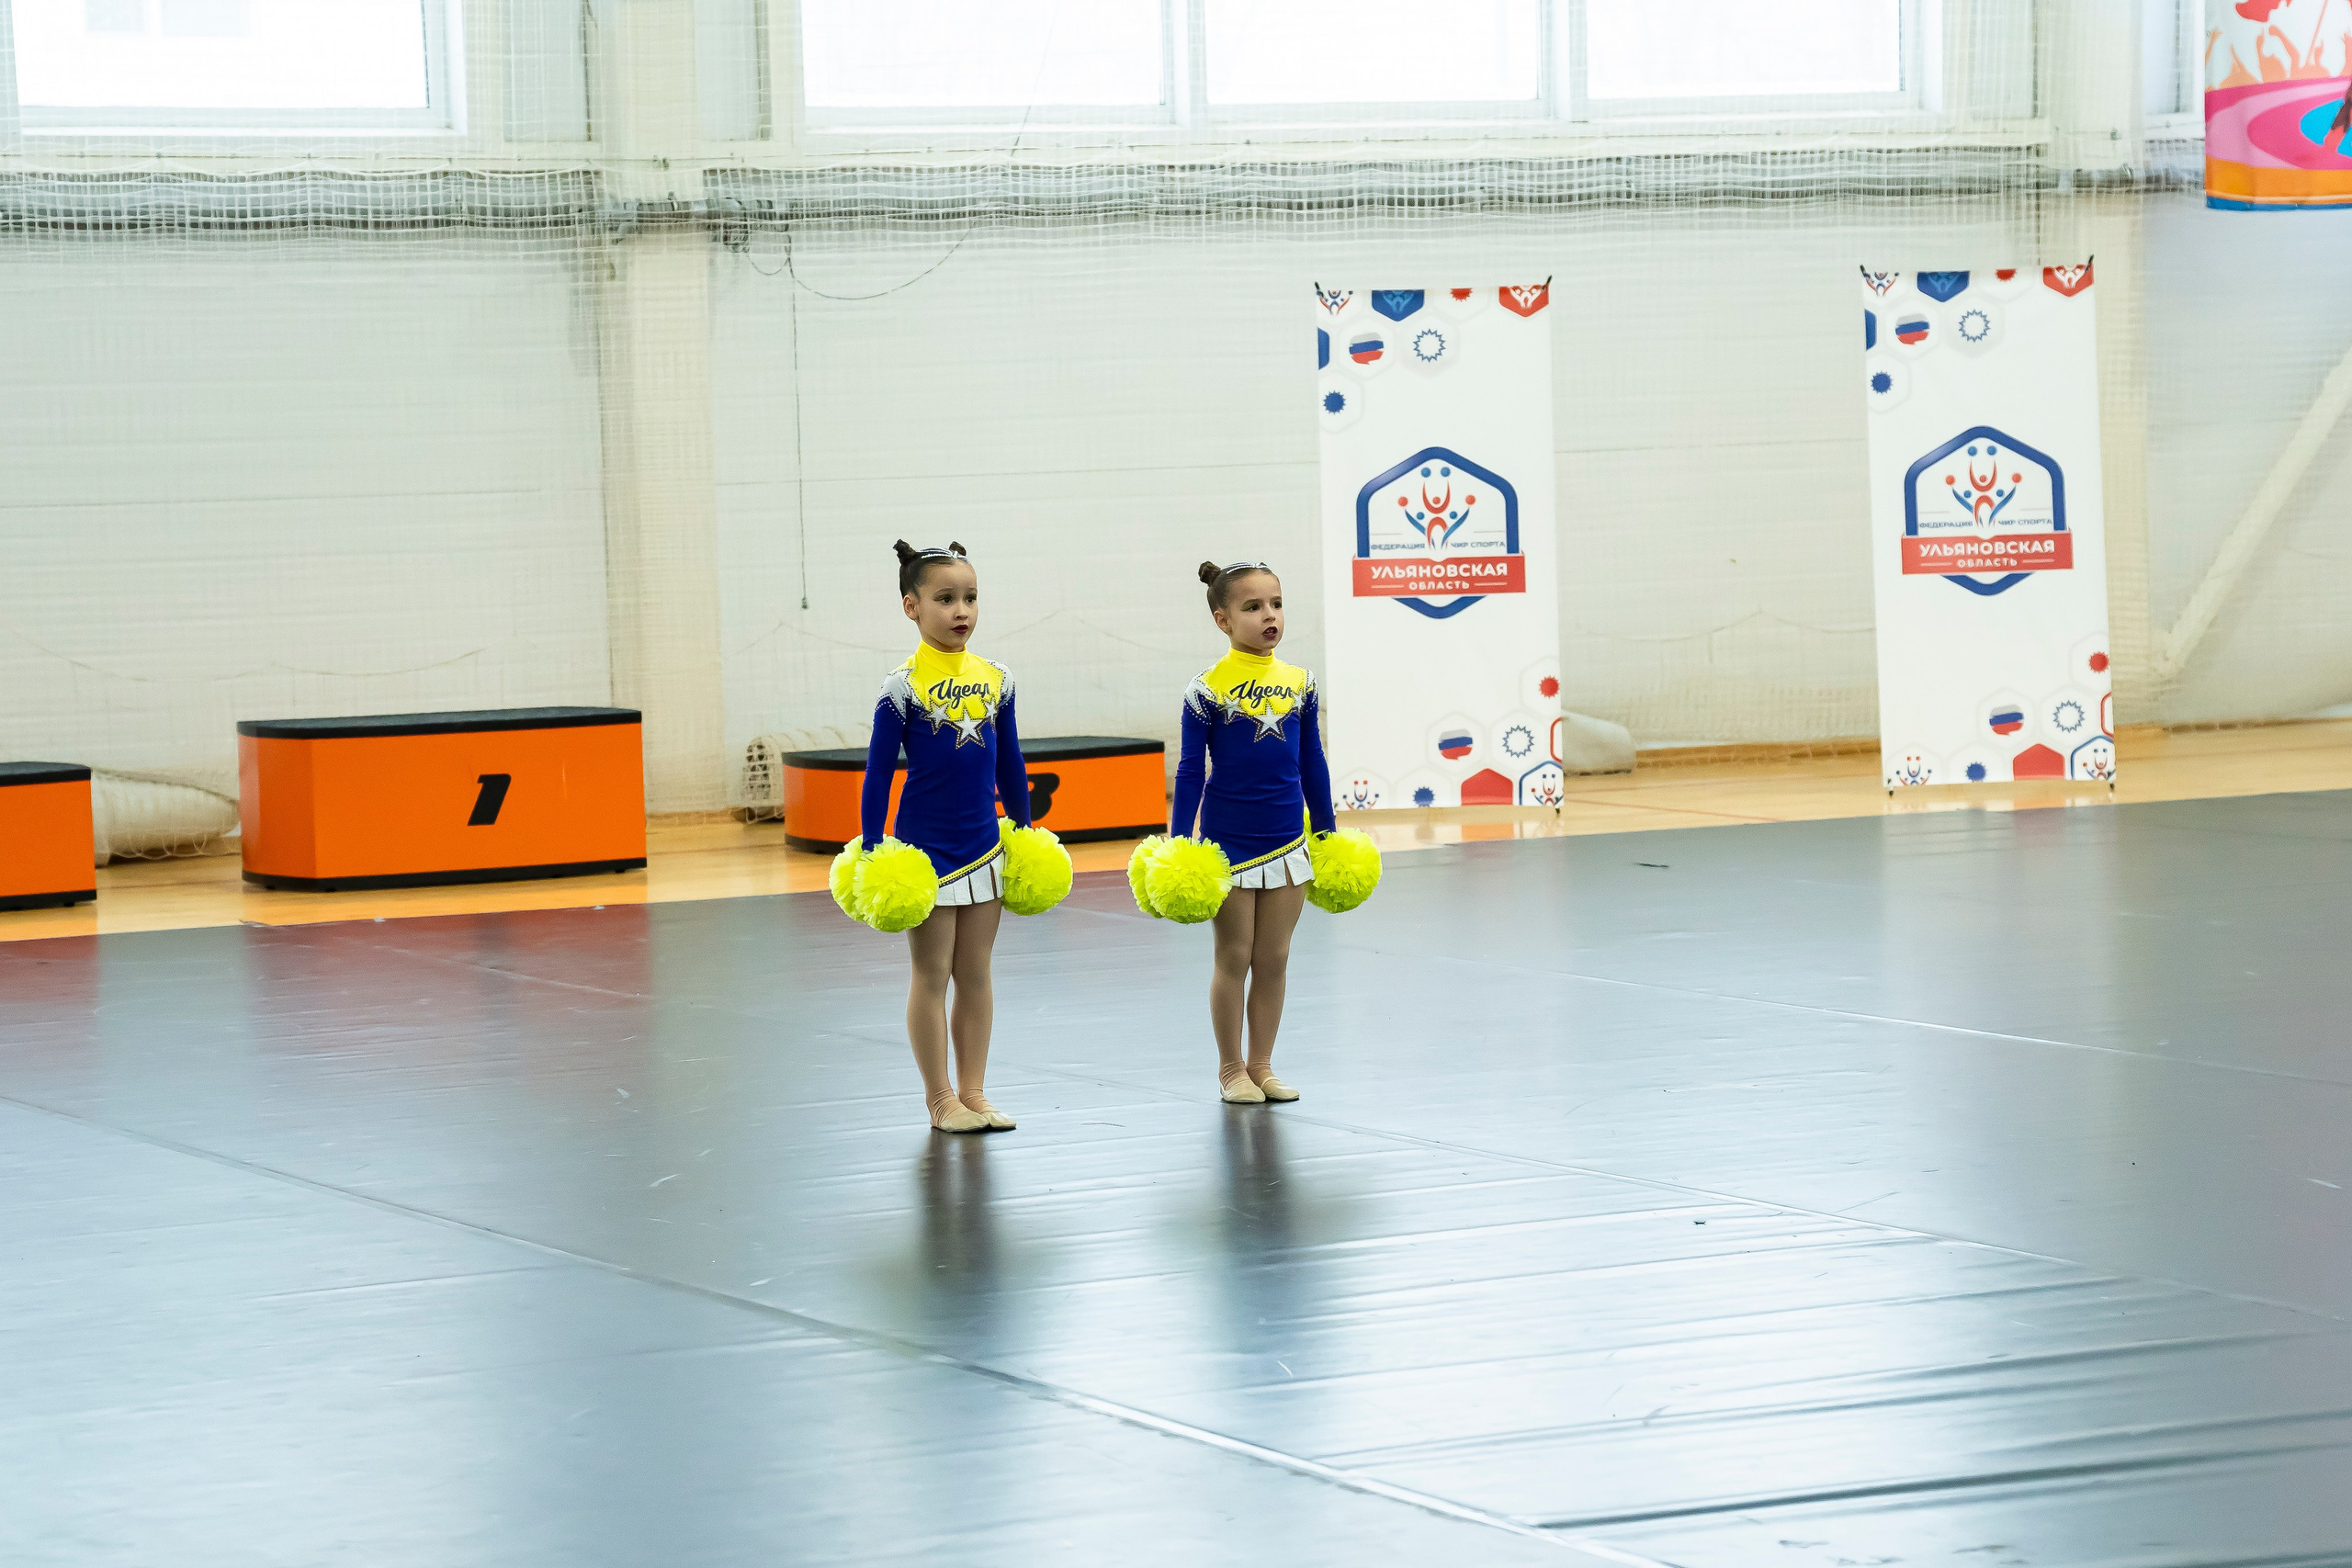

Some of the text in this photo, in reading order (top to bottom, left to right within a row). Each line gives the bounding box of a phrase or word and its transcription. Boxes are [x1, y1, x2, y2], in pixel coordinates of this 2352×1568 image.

[1919, 520, 1973, 529] ФЕДЕРАЦИЯ
[2018, 518, 2053, 526] СПОРТА
[1370, 543, 1425, 551] ФЕДЕРАЦИЯ
[1919, 539, 2055, 558] УЛЬЯНОВСКАЯ
[1956, 558, 2018, 569] ОБЛАСТЬ
[1371, 562, 1508, 580] УЛЬЯНОВСКАЯ
[1408, 581, 1470, 591] ОБЛАСТЬ
[928, 678, 990, 710] Идеал
[467, 773, 512, 827] 1
